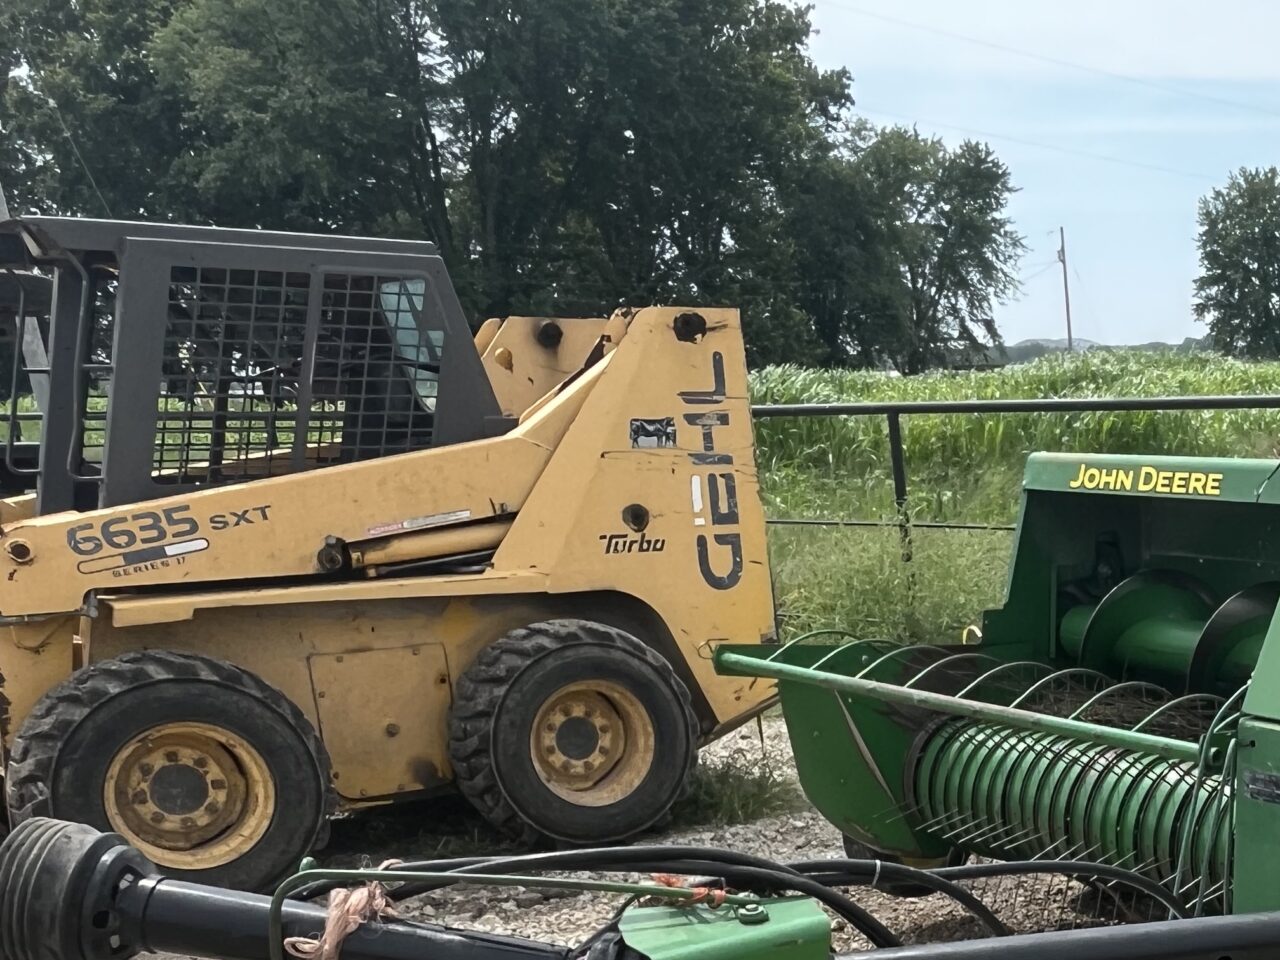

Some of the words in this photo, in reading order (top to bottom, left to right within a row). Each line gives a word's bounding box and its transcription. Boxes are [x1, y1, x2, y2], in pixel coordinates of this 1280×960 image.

[677, 351, 744, 590] GEHL
[1069, 463, 1134, 491] JOHN
[1137, 465, 1224, 496] DEERE
[66, 504, 200, 556] 6635
[209, 505, 272, 531] SXT
[599, 532, 666, 555] Turbo
[112, 559, 170, 578] SERIES
